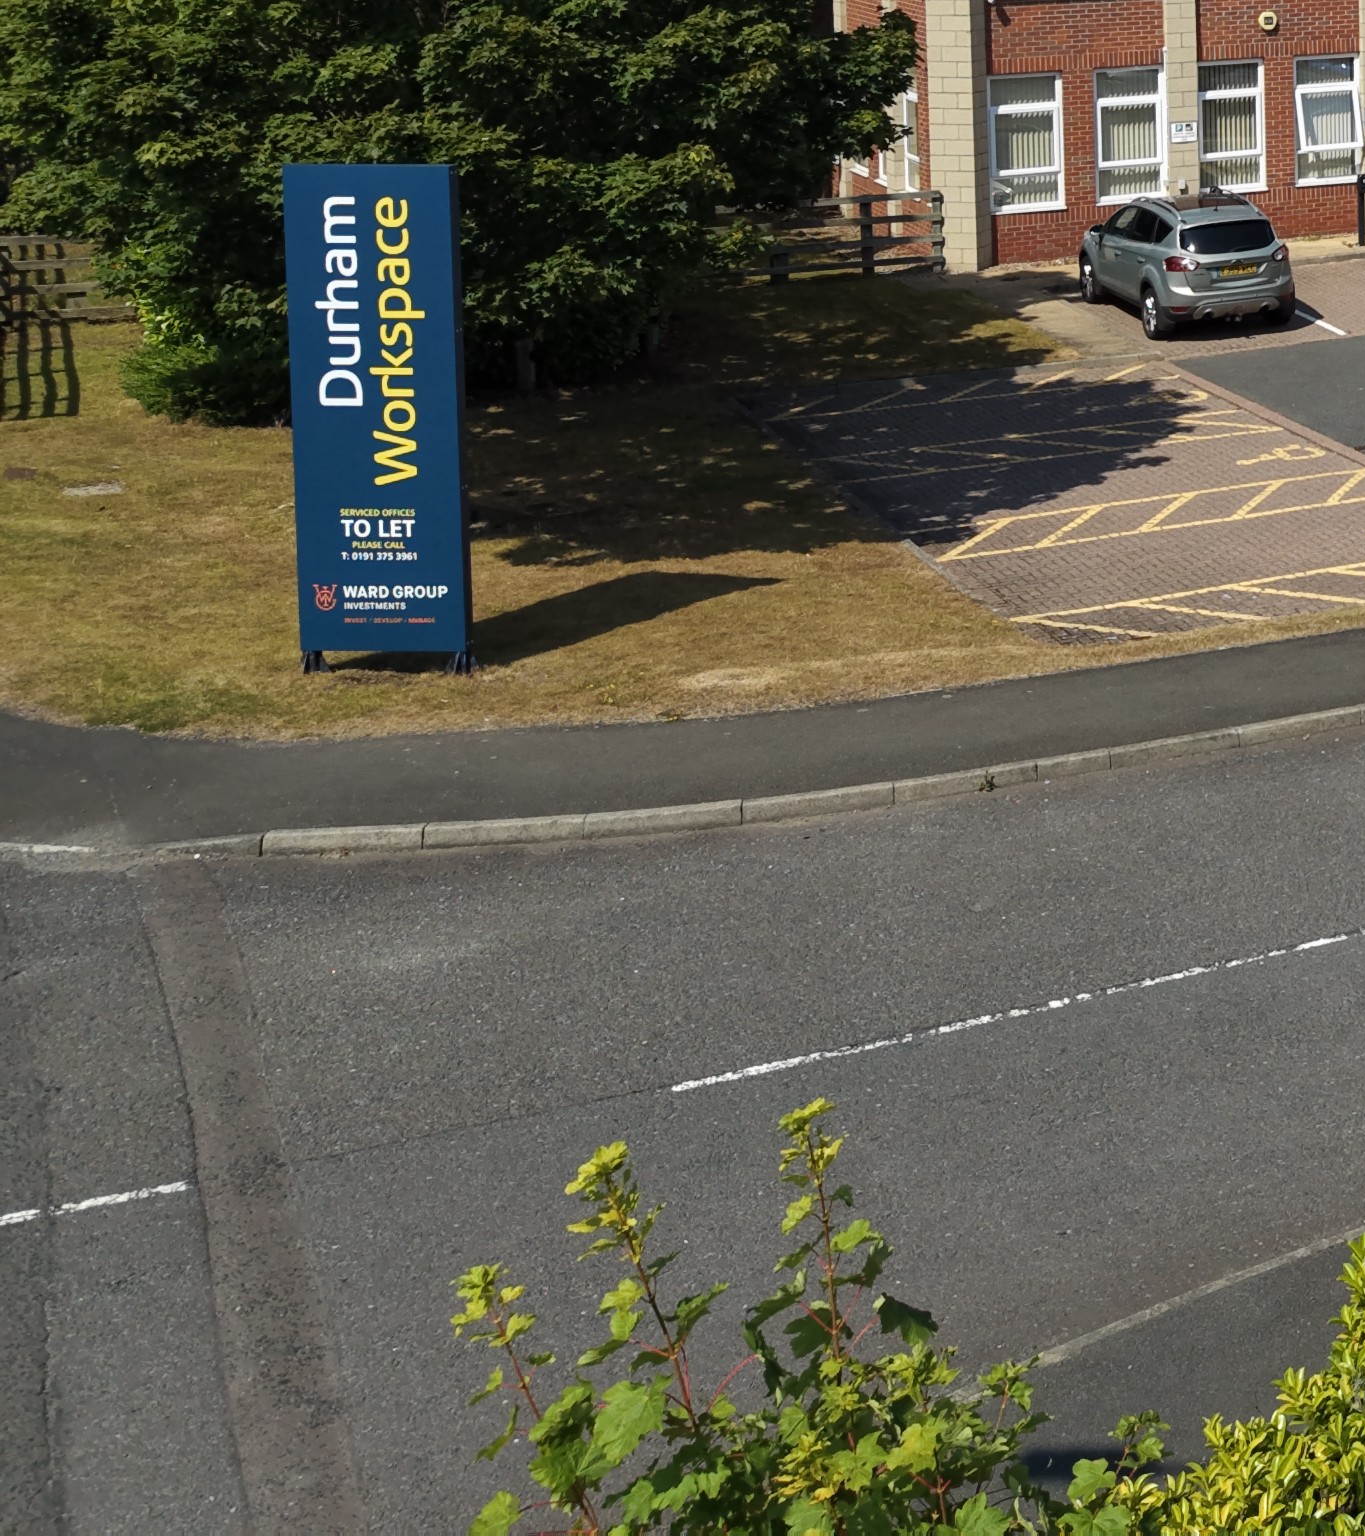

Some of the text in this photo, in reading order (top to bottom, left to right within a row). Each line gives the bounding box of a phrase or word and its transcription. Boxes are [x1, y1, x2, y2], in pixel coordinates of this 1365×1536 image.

[315, 195, 364, 407] Durham
[369, 196, 426, 486] Workspace
[340, 508, 416, 517] SERVICED OFFICES
[340, 519, 416, 538] TO LET
[352, 541, 405, 549] PLEASE CALL
[352, 552, 374, 561] 0191
[376, 552, 393, 561] 375
[395, 552, 418, 561] 3961
[343, 585, 448, 599] WARD GROUP
[344, 602, 406, 610] INVESTMENTS
